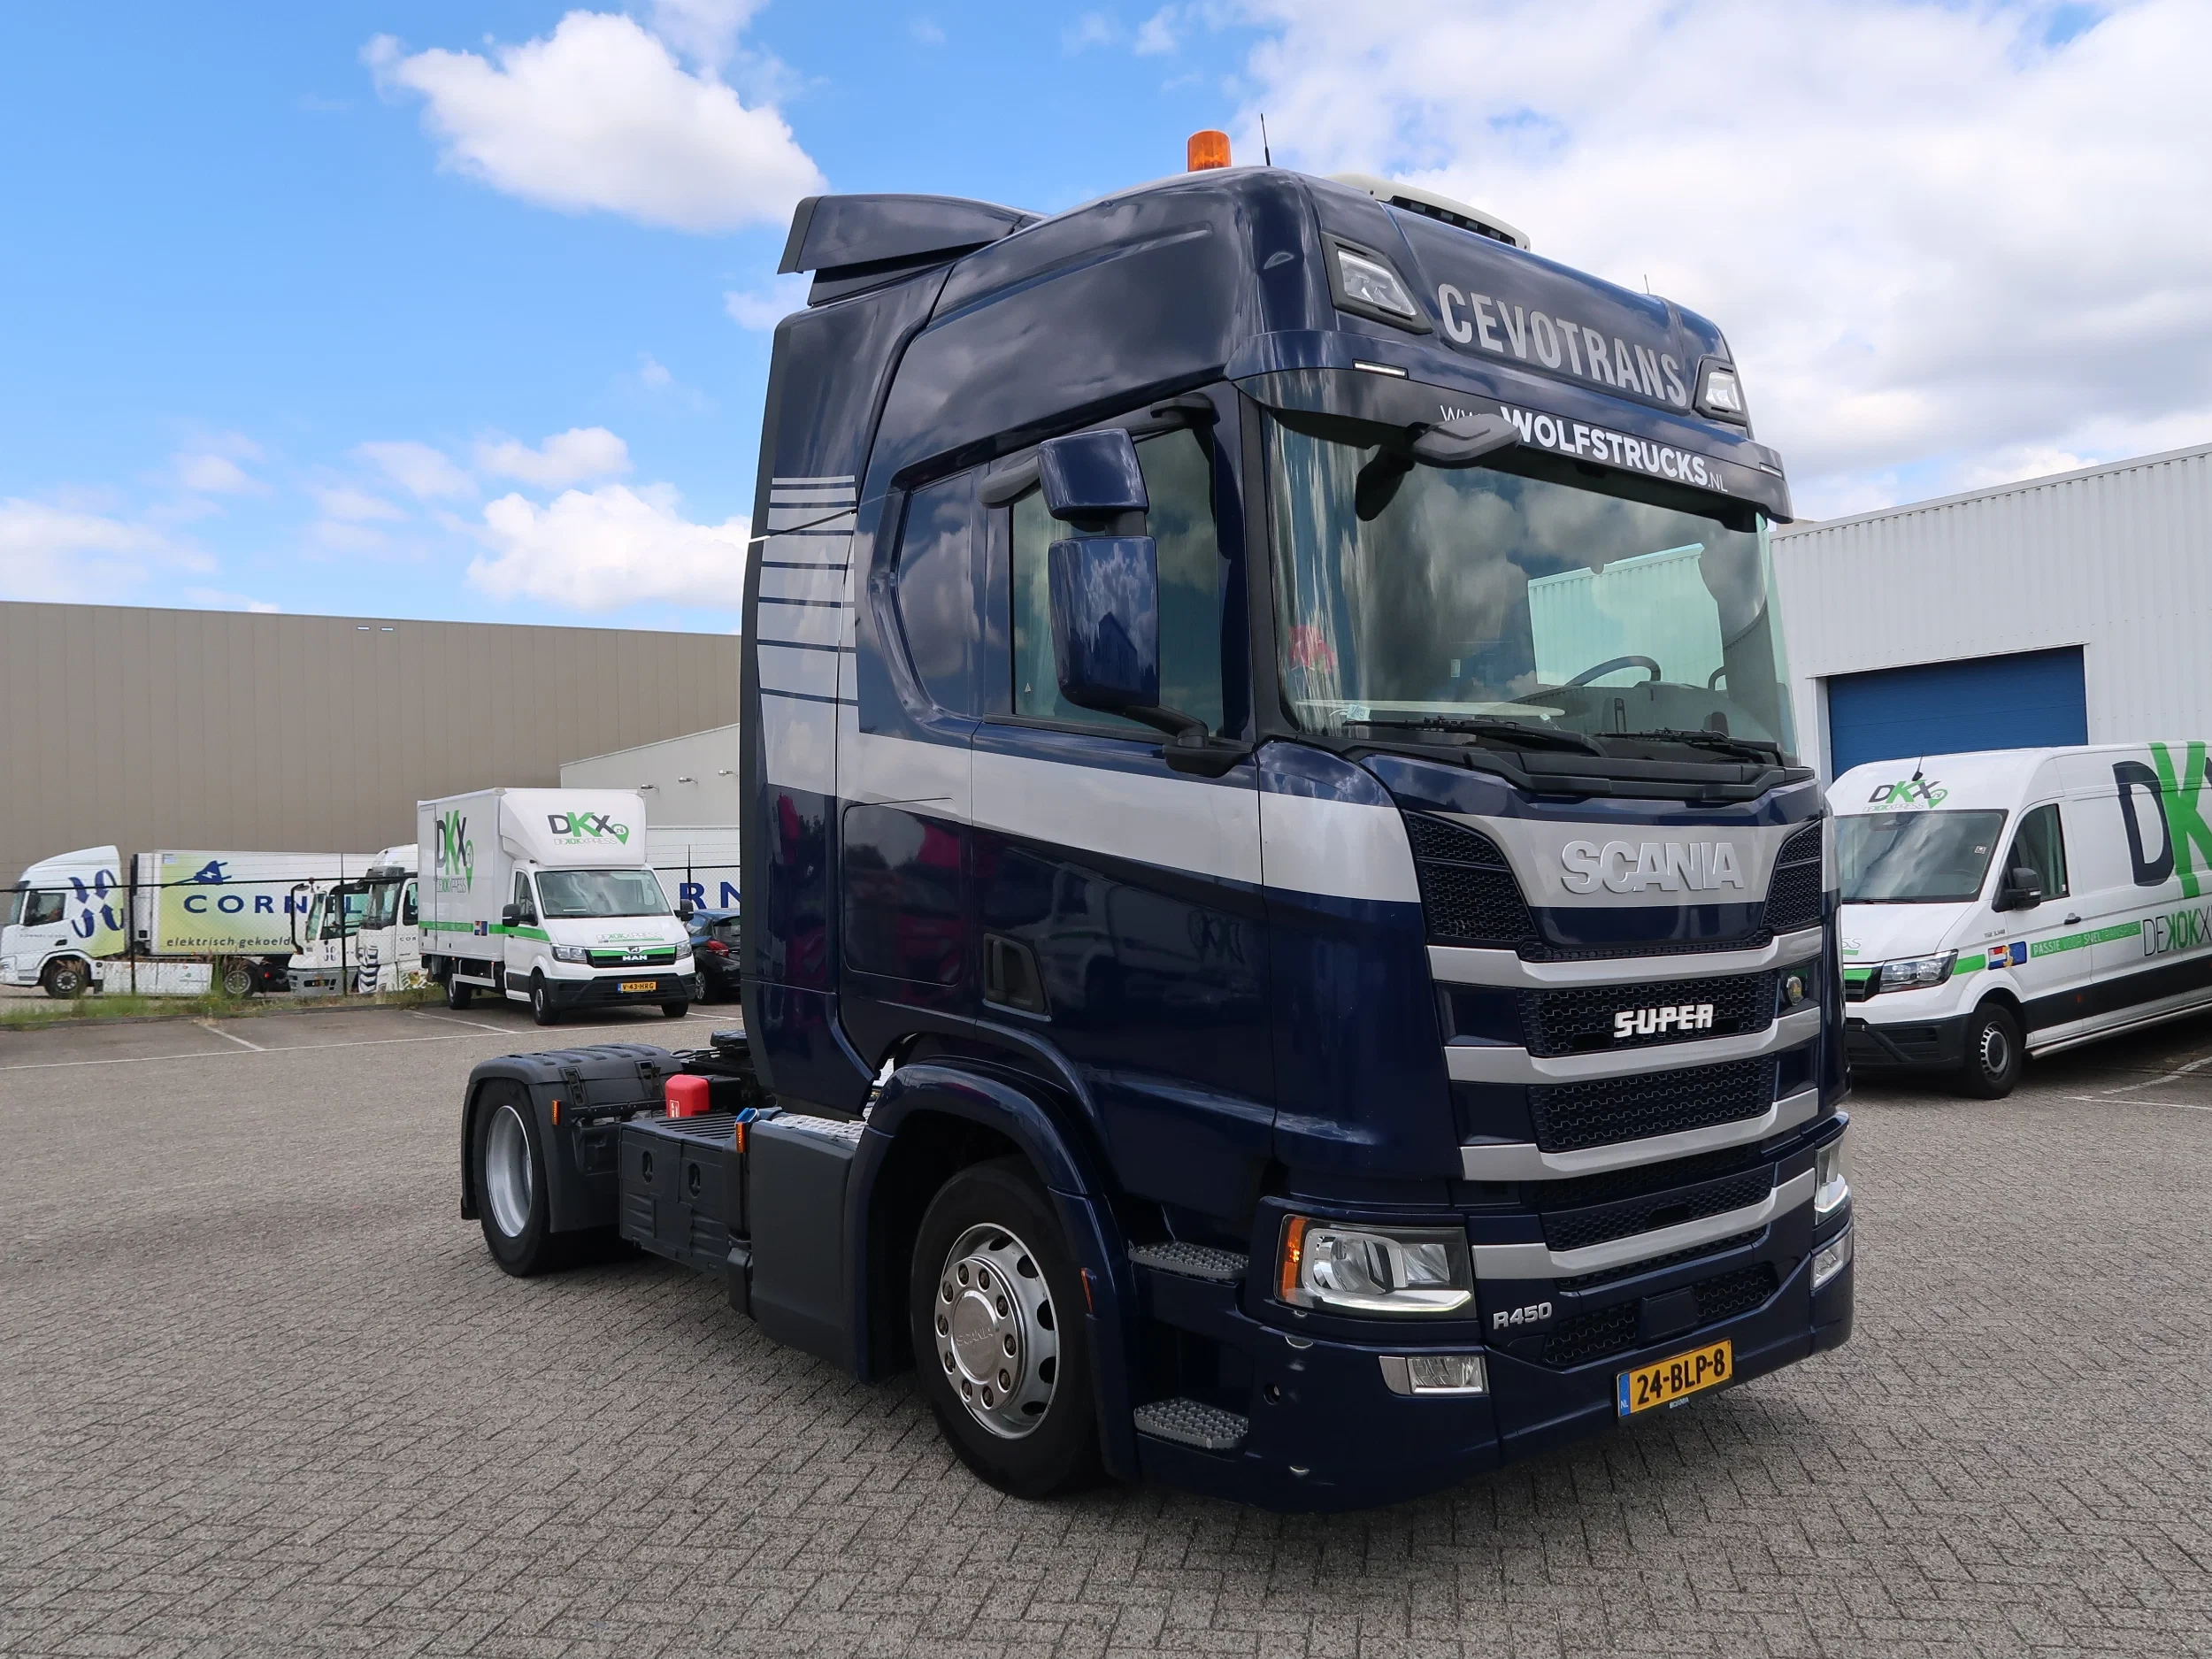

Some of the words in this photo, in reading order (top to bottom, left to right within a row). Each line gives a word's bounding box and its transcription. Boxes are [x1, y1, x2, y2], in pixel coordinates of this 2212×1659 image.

[1438, 283, 1688, 407] CEVOTRANS
[1868, 780, 1941, 803] DKX
[547, 811, 617, 837] DKX
[2112, 741, 2212, 899] DK
[1561, 840, 1745, 895] SCANIA
[166, 936, 234, 948] elektrisch
[239, 936, 292, 949] gekoeld
[2143, 905, 2212, 956] DEKOKX
[2032, 941, 2061, 956] PASSIE
[1614, 1004, 1714, 1038] SUPER
[1494, 1302, 1552, 1329] R450
[1637, 1348, 1725, 1405] 24-BLP-8
[1620, 1400, 1629, 1409] NL
